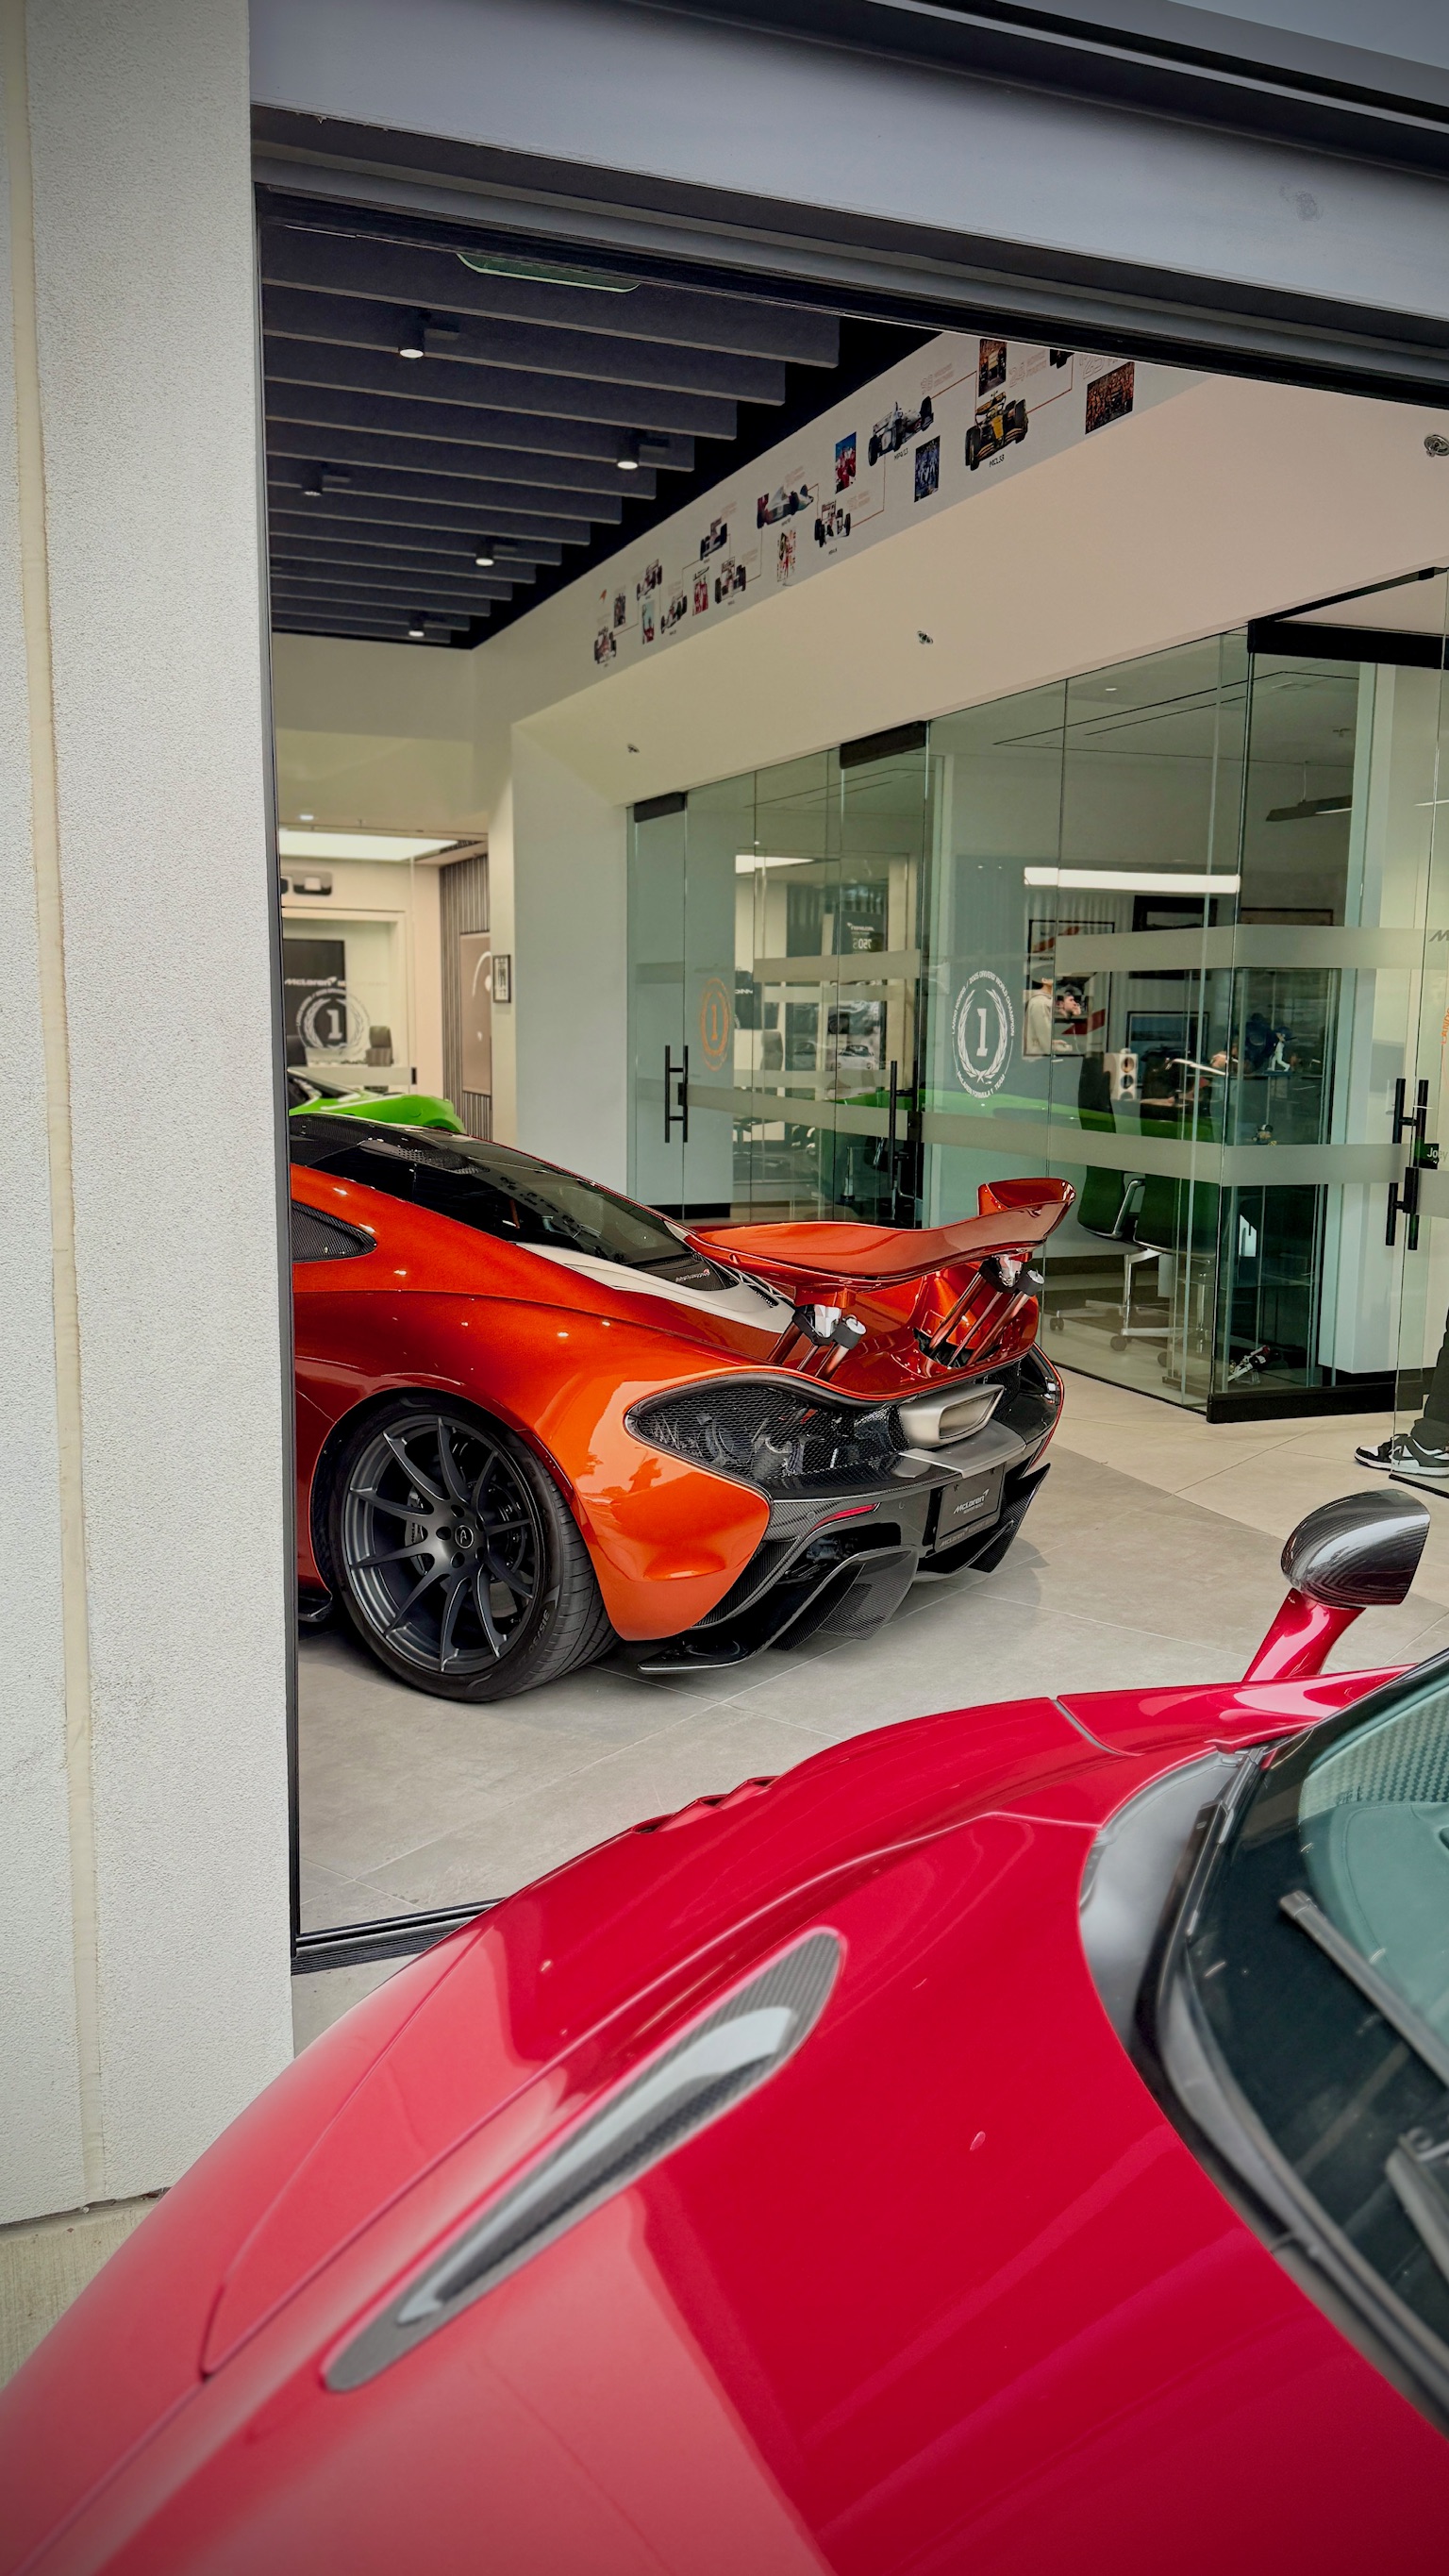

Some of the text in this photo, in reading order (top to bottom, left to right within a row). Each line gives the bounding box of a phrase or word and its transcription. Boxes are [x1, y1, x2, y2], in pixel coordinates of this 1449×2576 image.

[325, 1009, 342, 1039] 1
[976, 1008, 988, 1056] 1
[1426, 1146, 1448, 1162] Joey
[953, 1495, 985, 1514] McLaren
